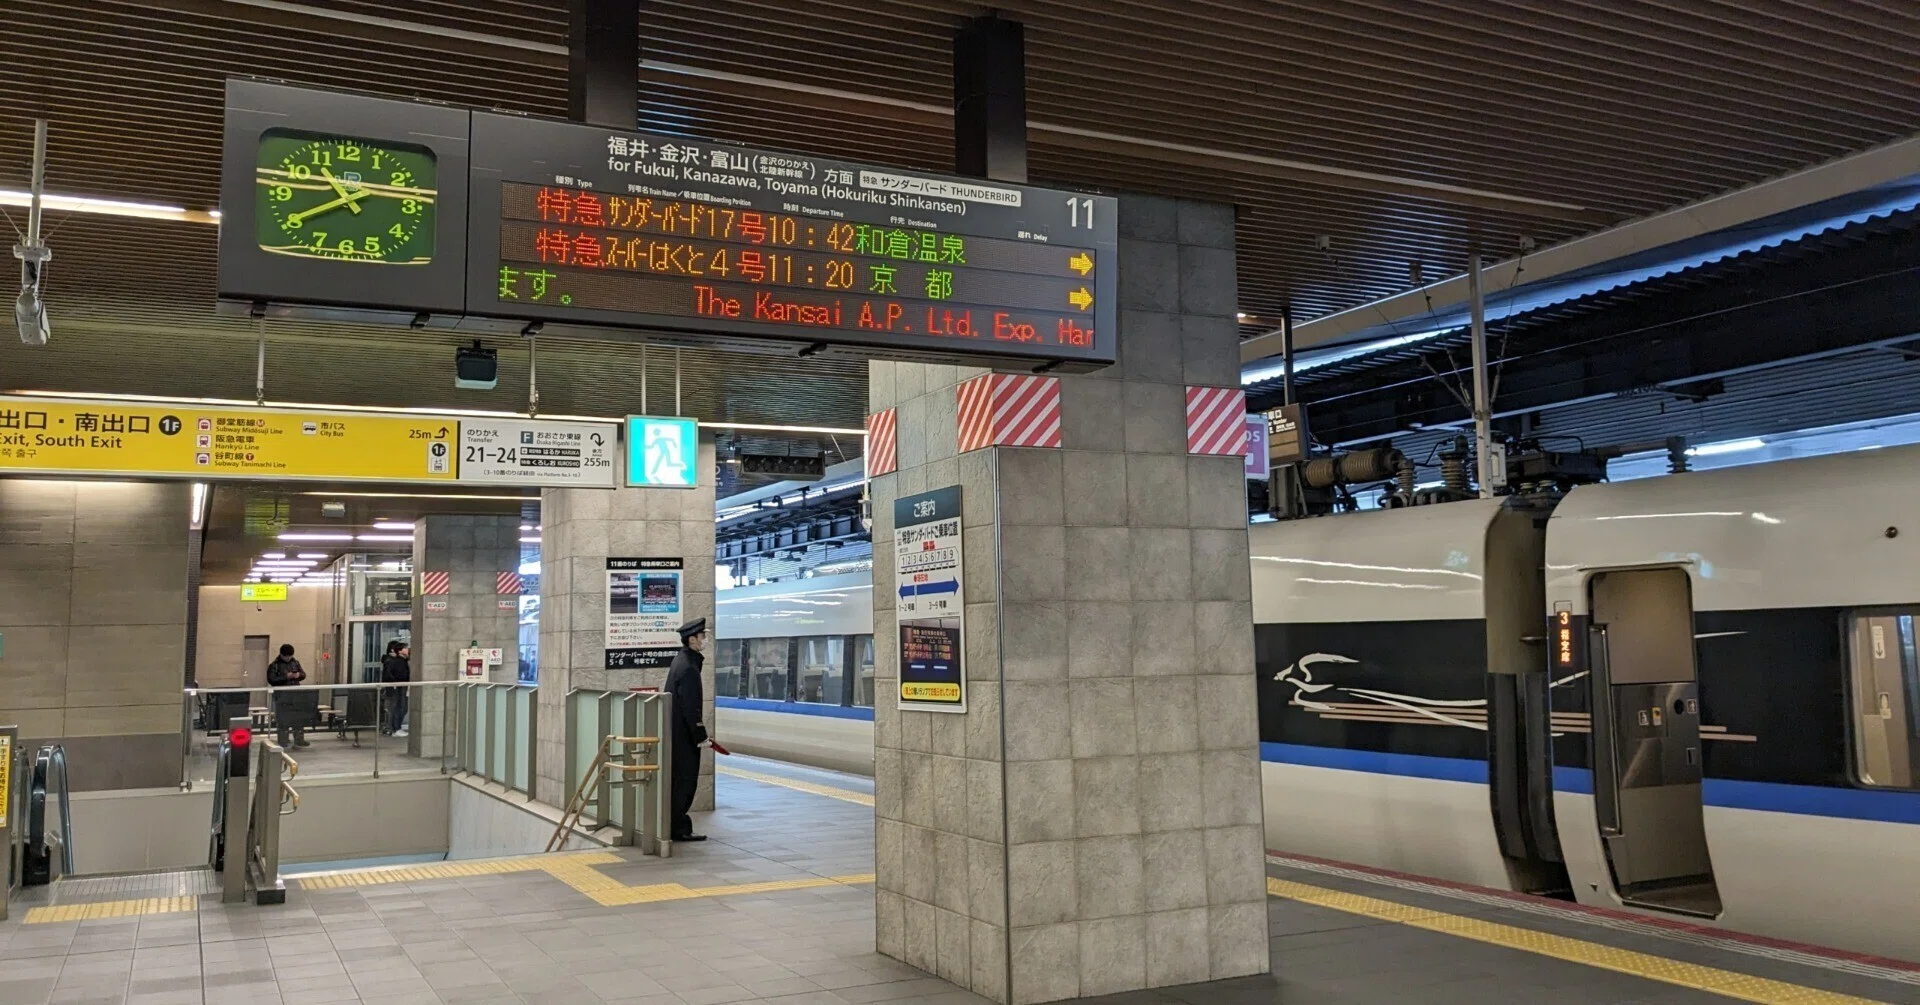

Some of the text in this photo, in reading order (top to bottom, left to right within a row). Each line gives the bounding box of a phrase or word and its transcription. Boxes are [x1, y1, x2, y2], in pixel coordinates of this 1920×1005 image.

[311, 150, 332, 166] 11
[337, 145, 361, 162] 12
[607, 136, 853, 185] 福井・金沢・富山 金沢のりかえ 方面
[371, 155, 381, 170] 1
[287, 164, 311, 180] 10
[760, 165, 803, 179] 北陸新幹線
[391, 172, 405, 187] 2
[555, 175, 573, 186] 種別
[577, 179, 593, 188] Type
[862, 175, 947, 194] 特急 サンダーバード
[276, 186, 292, 201] 9
[607, 158, 966, 216] for Fukui, Kanazawa, Toyama (Hokuriku Shinkansen)
[649, 187, 677, 198] Train Name
[711, 195, 751, 206] Boarding Position
[951, 186, 1018, 203] THUNDERBIRD
[402, 199, 416, 214] 3
[783, 203, 799, 212] 時刻
[802, 206, 844, 218] Departure Time
[1067, 197, 1094, 229] 11
[286, 213, 303, 229] 8
[537, 187, 606, 227] 特急
[856, 224, 966, 265] 和倉温泉
[890, 216, 905, 225] 行先
[908, 219, 937, 229] Destination
[389, 223, 404, 238] 4
[1033, 233, 1048, 242] Delay
[312, 232, 328, 247] 7
[364, 236, 380, 252] 5
[338, 240, 354, 255] 6
[536, 228, 606, 268] 特急
[693, 285, 741, 318] The
[755, 291, 841, 326] Kansai
[858, 301, 911, 332] A.P.
[927, 307, 979, 337] Ltd.
[994, 312, 1043, 343] Exp.
[162, 418, 180, 432] 1F
[216, 426, 241, 434] Subway
[321, 422, 346, 430] 市バス
[215, 435, 255, 443] 阪急電車
[409, 429, 431, 439] 25m
[467, 429, 499, 437] のりかえ
[523, 432, 531, 443] F
[537, 432, 581, 441] おおさか東線
[36, 433, 85, 448] South
[91, 436, 122, 449] Exit
[215, 452, 244, 460] 谷町線
[433, 445, 445, 454] 1F
[215, 460, 239, 468] Subway
[584, 457, 610, 467] 255m
[913, 499, 935, 518] ご案内
[1560, 611, 1569, 625] 3
